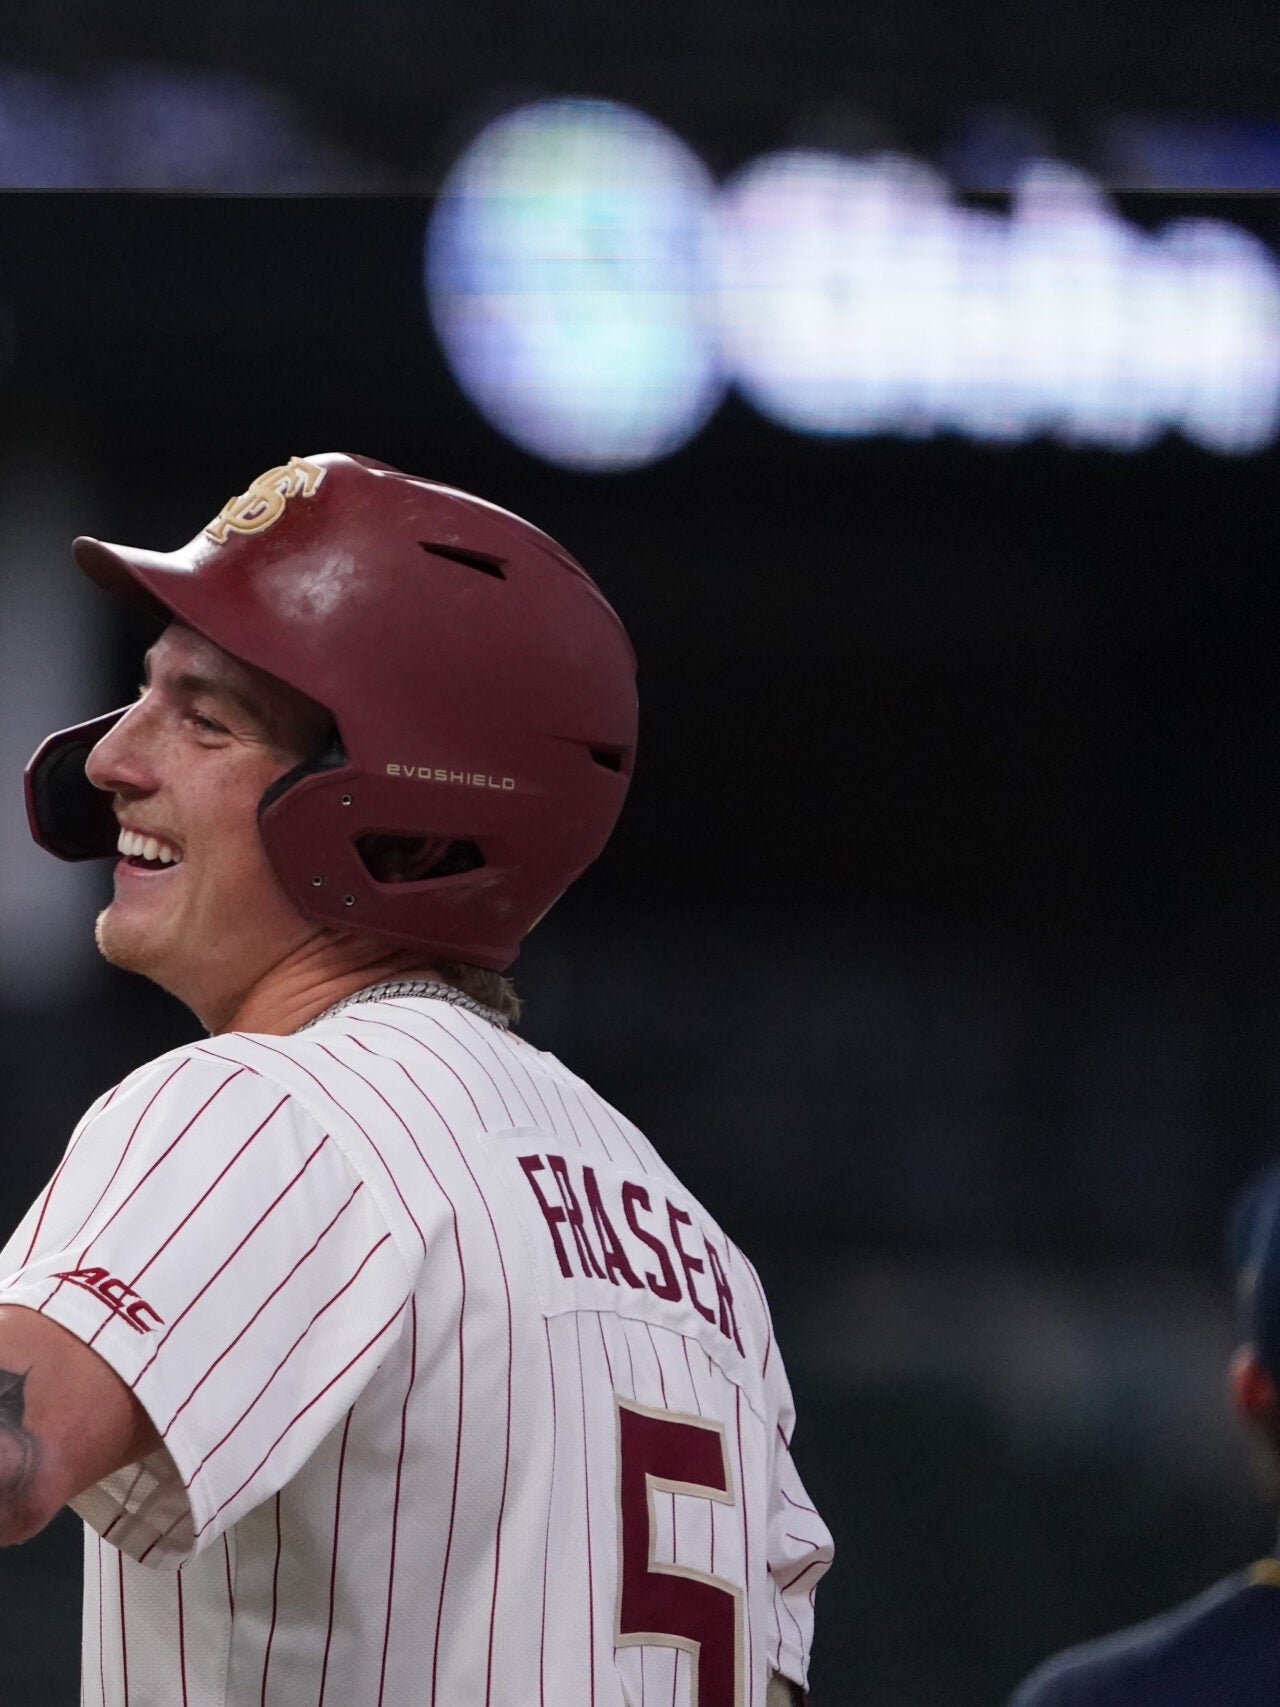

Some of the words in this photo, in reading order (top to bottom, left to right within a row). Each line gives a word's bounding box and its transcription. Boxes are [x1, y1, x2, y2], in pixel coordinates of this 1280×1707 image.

[47, 1267, 166, 1334] ACC
[516, 1153, 746, 1358] FRASER
[613, 1393, 744, 1707] 5
